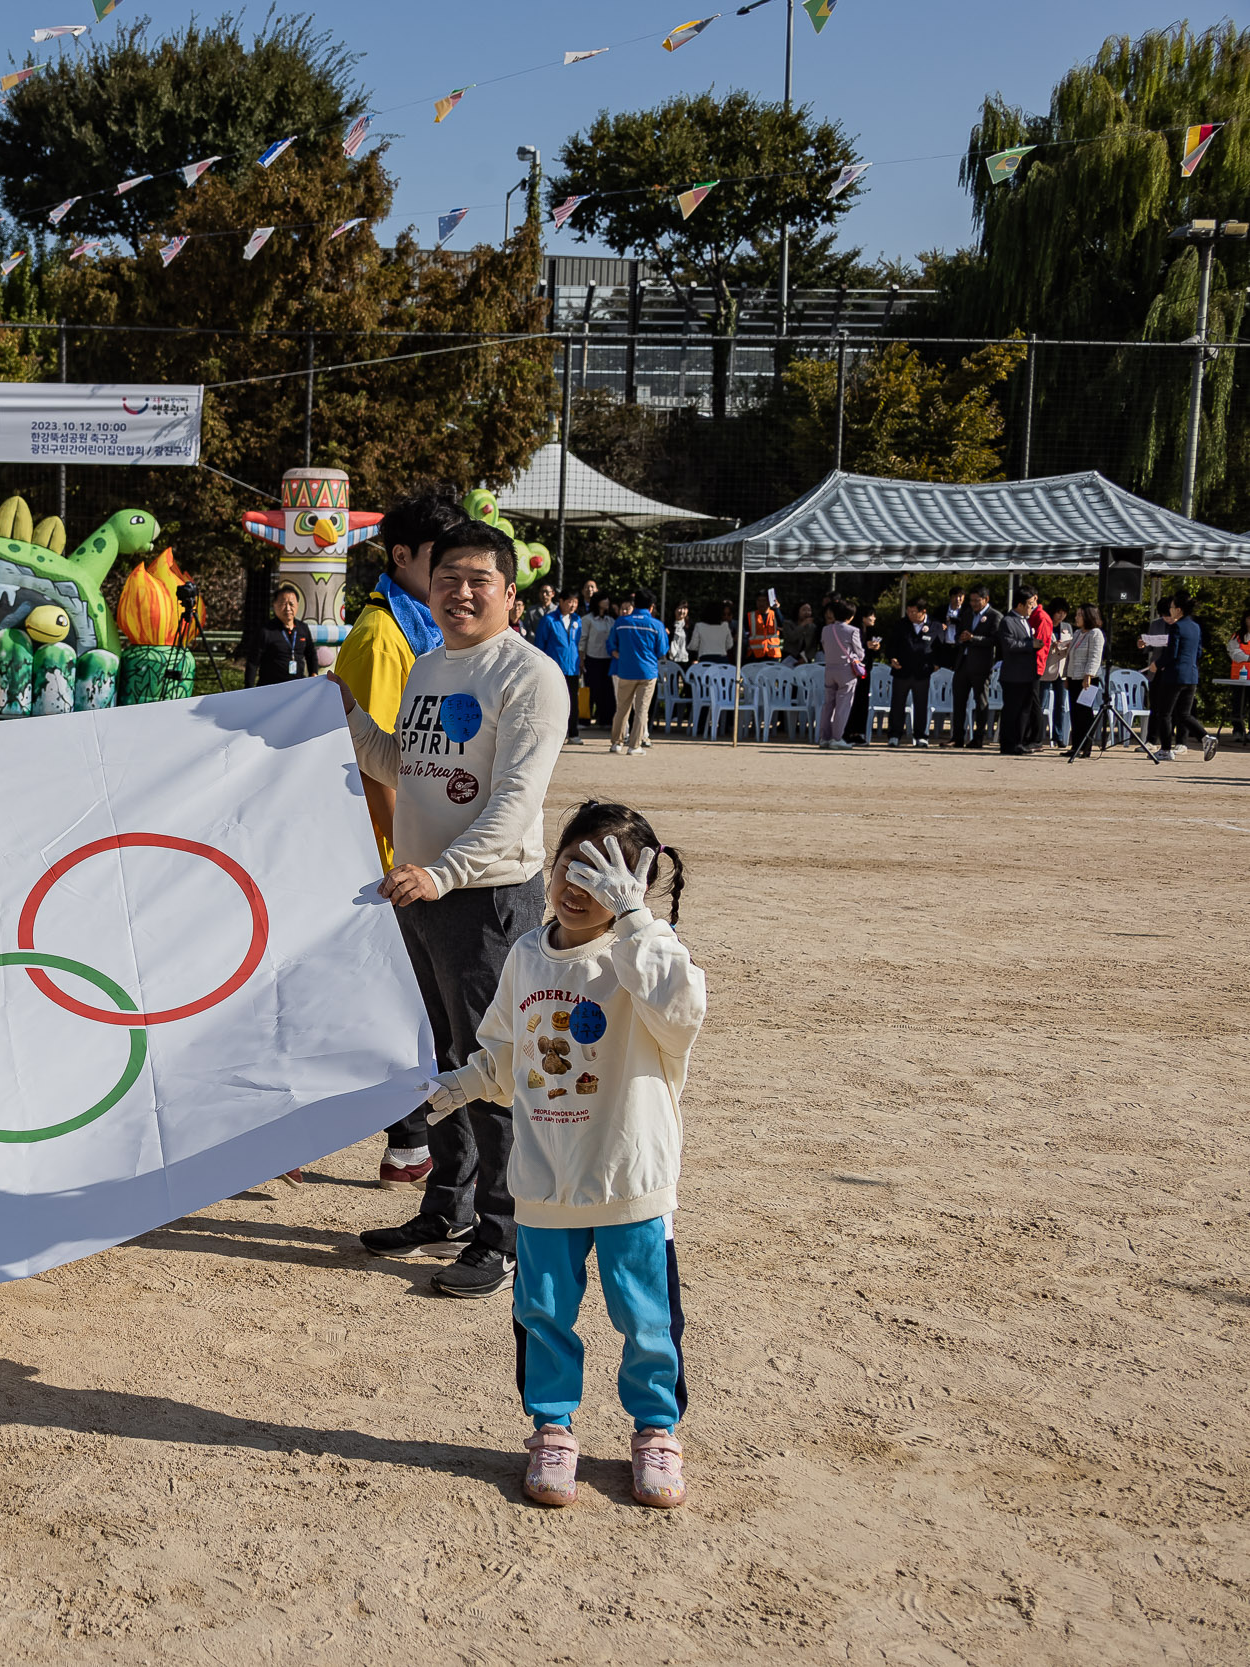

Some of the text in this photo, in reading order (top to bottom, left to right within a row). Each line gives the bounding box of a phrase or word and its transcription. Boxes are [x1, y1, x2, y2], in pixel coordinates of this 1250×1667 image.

[90, 433, 119, 444] 축구장
[414, 760, 424, 776] To
[519, 989, 601, 1013] WONDERLA
